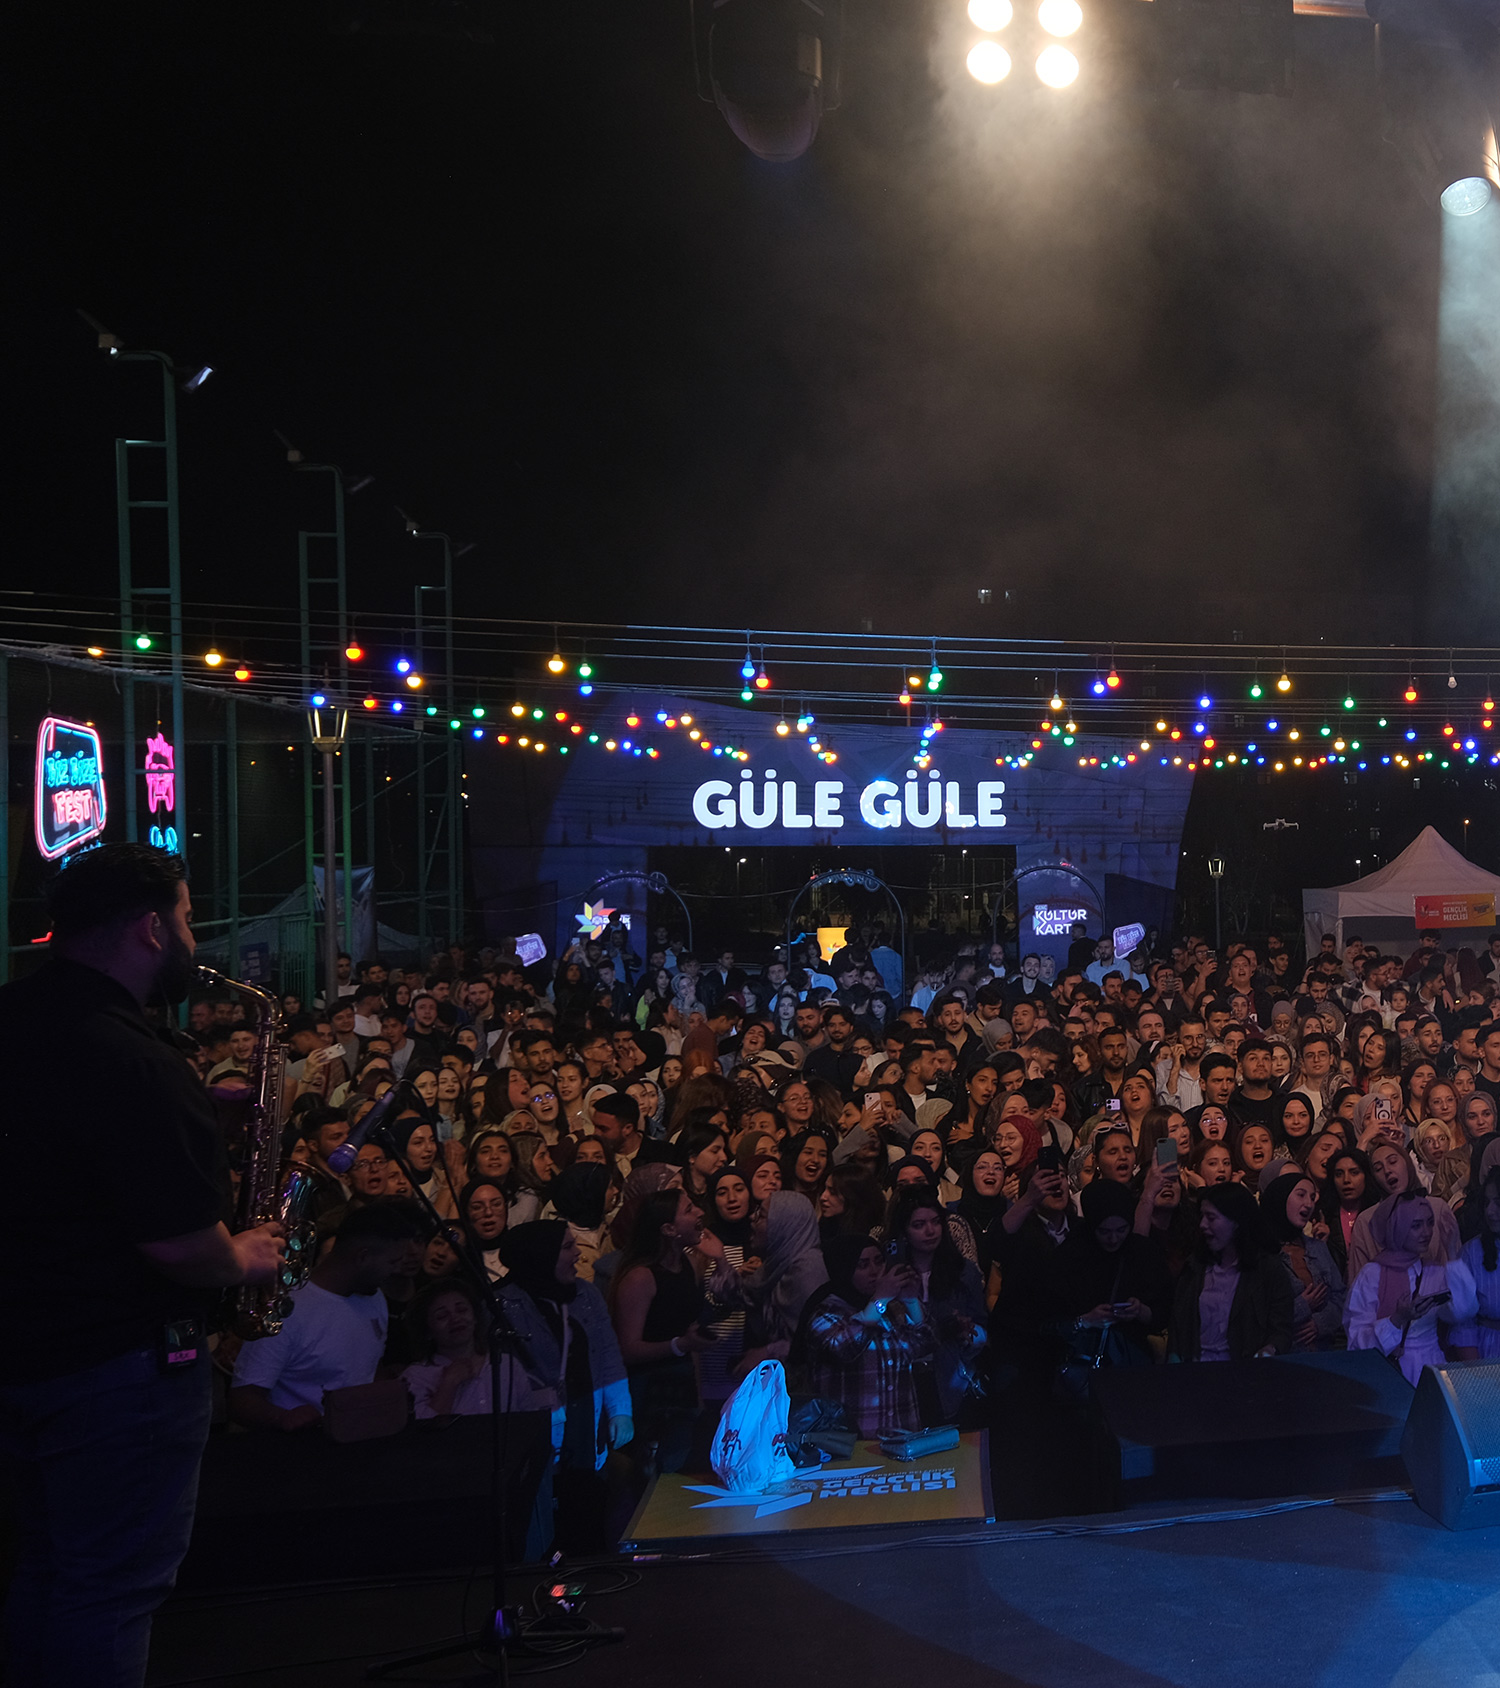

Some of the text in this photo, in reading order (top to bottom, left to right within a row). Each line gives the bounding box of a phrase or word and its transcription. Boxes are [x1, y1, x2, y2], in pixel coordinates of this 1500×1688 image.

[53, 789, 92, 824] FEST
[692, 768, 1007, 829] GÜLE GÜLE
[1036, 923, 1072, 935] KART
